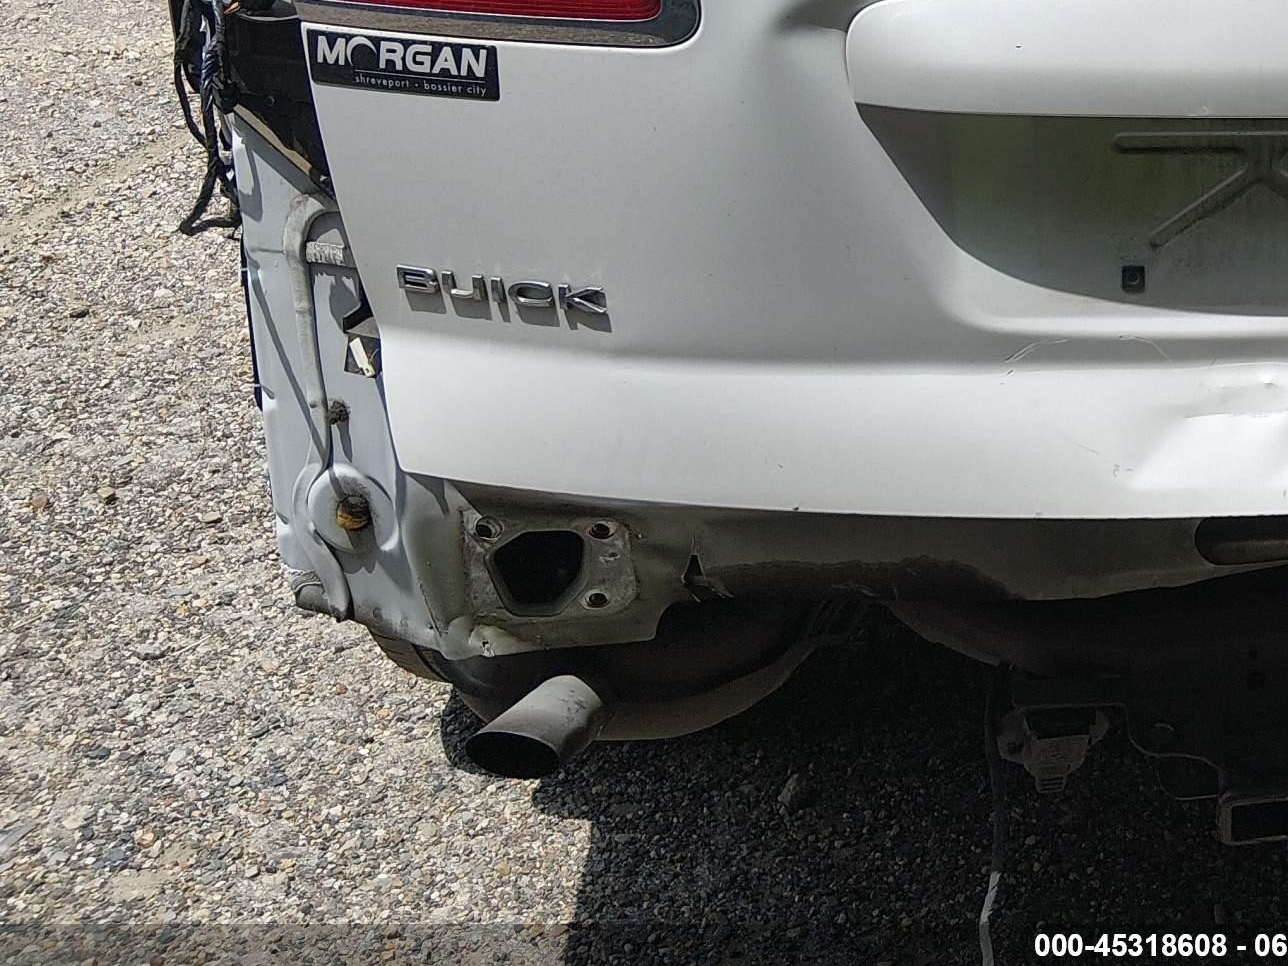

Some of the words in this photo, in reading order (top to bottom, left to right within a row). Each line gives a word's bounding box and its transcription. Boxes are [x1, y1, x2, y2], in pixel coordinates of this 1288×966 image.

[316, 35, 488, 78] MORGAN
[355, 74, 410, 89] shreveport
[423, 80, 463, 94] bossier
[466, 85, 488, 97] city
[396, 264, 608, 313] BUICK
